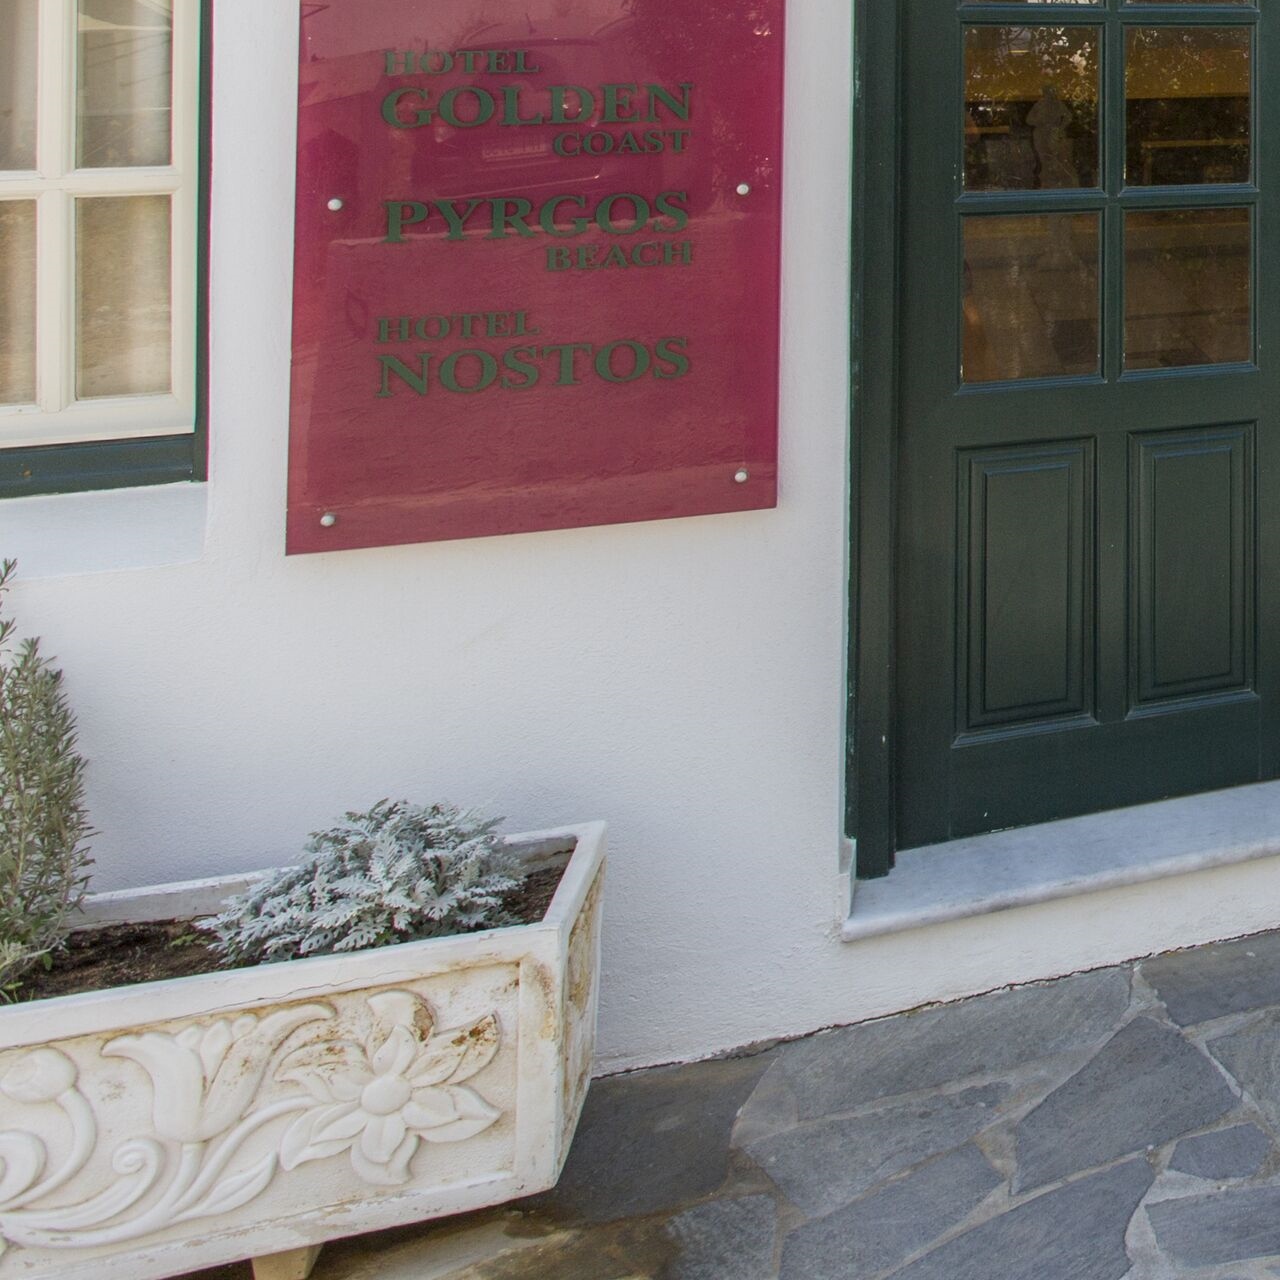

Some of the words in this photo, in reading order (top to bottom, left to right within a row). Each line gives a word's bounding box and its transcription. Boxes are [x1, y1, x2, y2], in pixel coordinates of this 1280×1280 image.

[384, 49, 539, 76] HOTEL
[380, 82, 694, 130] GOLDEN
[553, 129, 692, 156] COAST
[383, 191, 690, 244] PYRGOS
[545, 239, 693, 272] BEACH
[375, 310, 541, 344] HOTEL
[374, 335, 691, 399] NOSTOS
